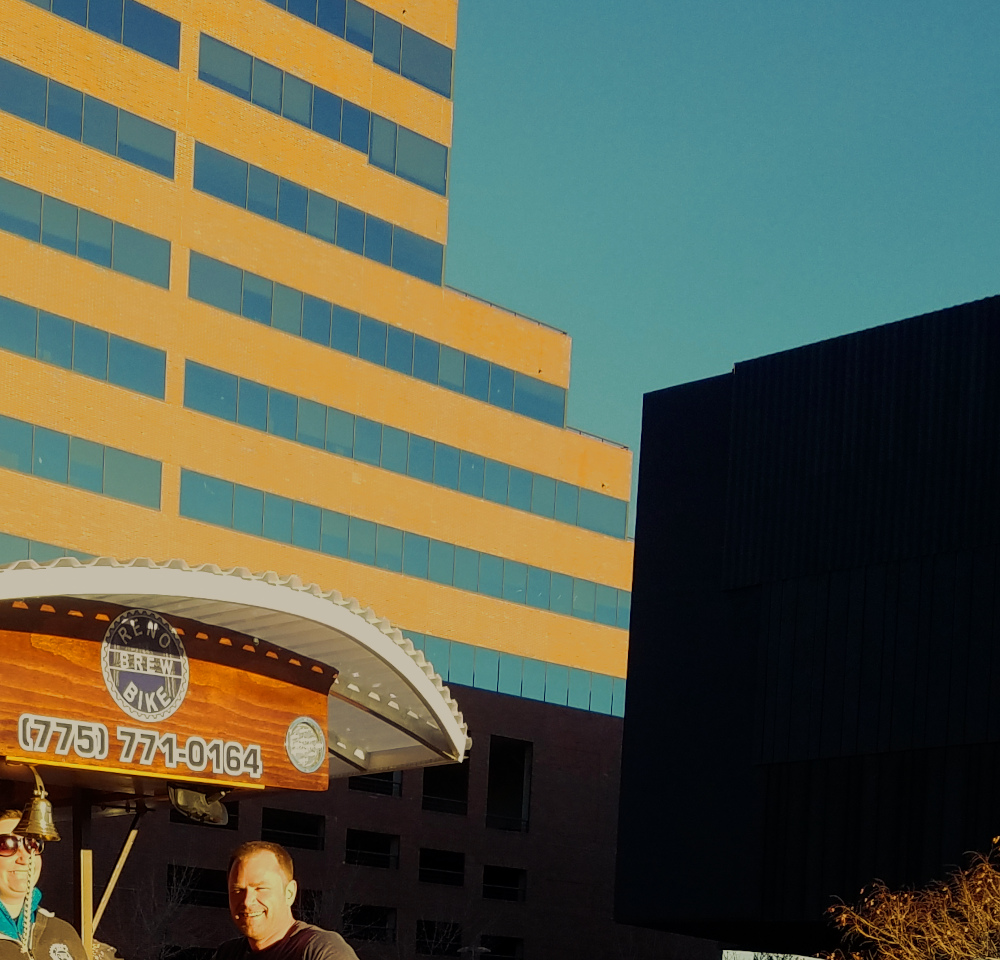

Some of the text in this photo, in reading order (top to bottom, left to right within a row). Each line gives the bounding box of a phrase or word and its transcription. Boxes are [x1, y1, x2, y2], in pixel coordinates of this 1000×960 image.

[117, 618, 172, 649] RENO
[119, 651, 174, 676] BREW
[122, 680, 172, 713] BIKE
[18, 713, 262, 778] (775) 771-0164
